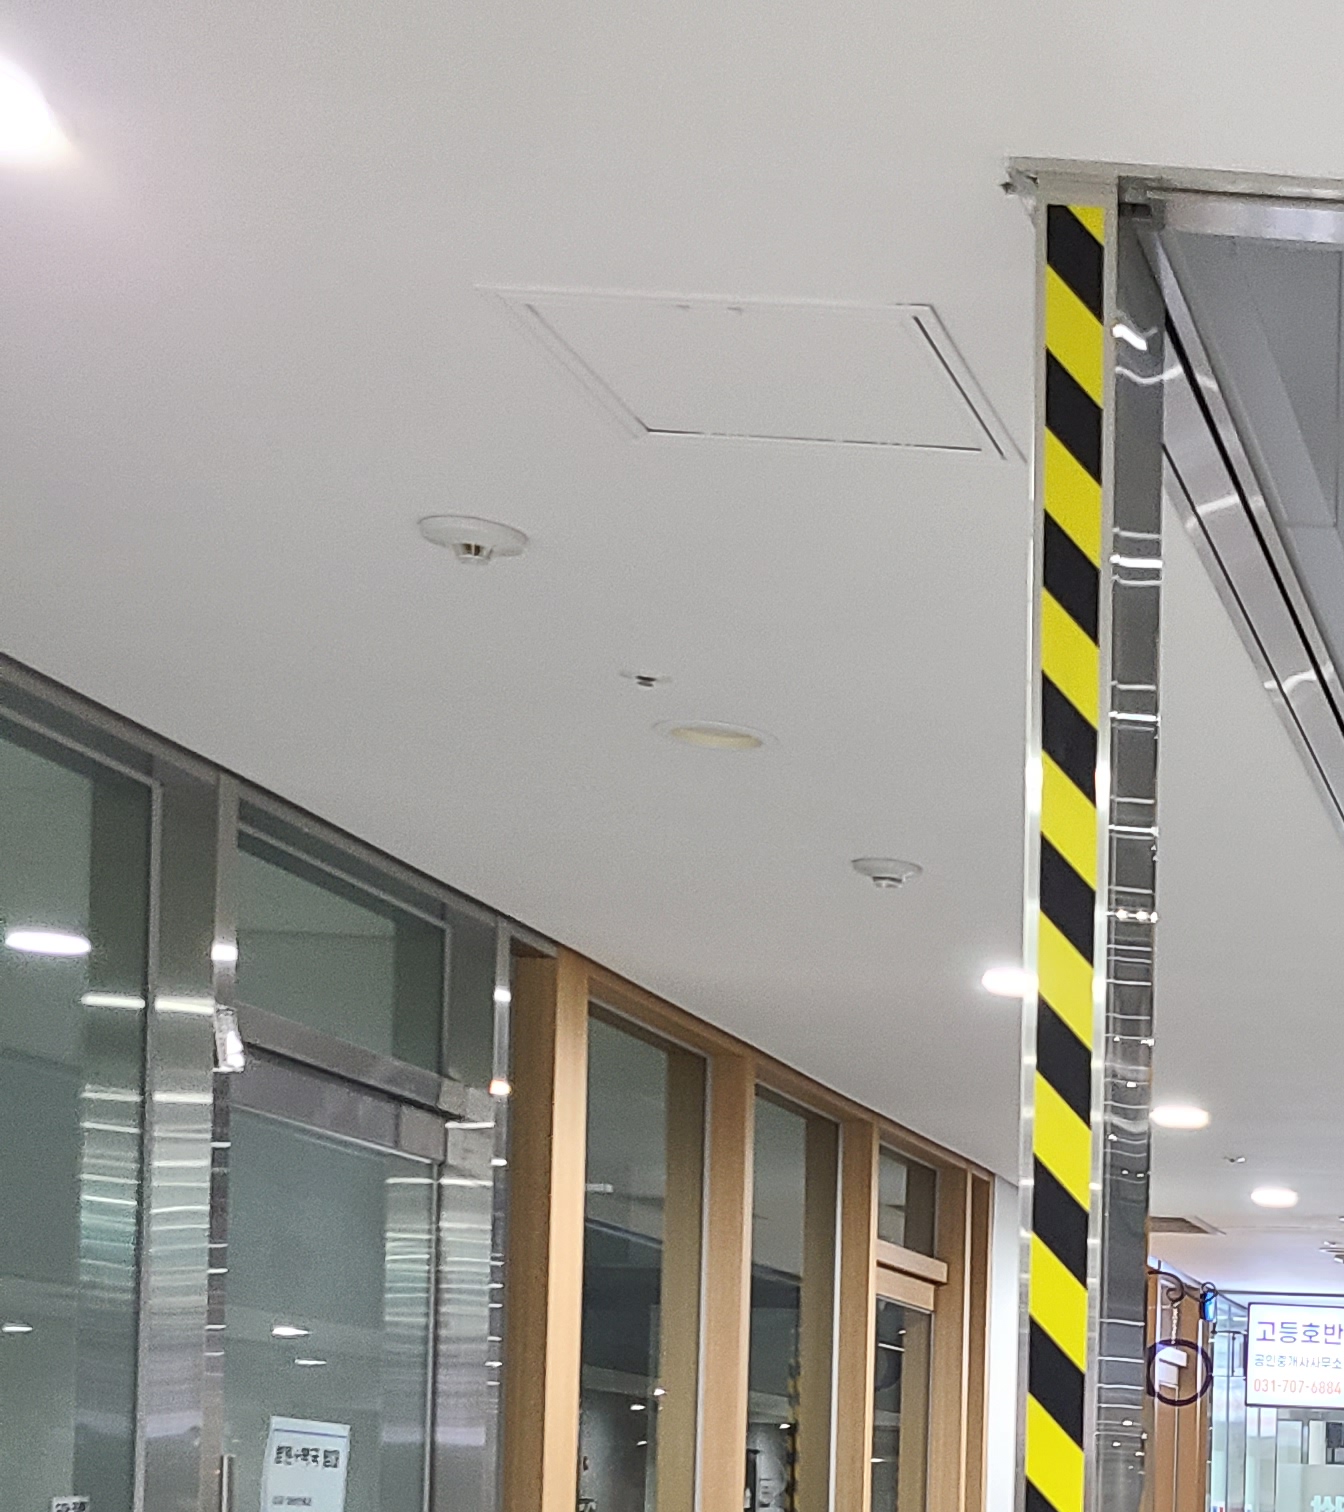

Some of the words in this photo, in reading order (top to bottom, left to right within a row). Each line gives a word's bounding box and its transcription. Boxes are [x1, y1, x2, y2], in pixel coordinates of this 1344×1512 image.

[1255, 1321, 1344, 1345] 고등호반
[1254, 1353, 1343, 1369] 공인중개사사무소
[1253, 1378, 1342, 1395] 031-707-6884
